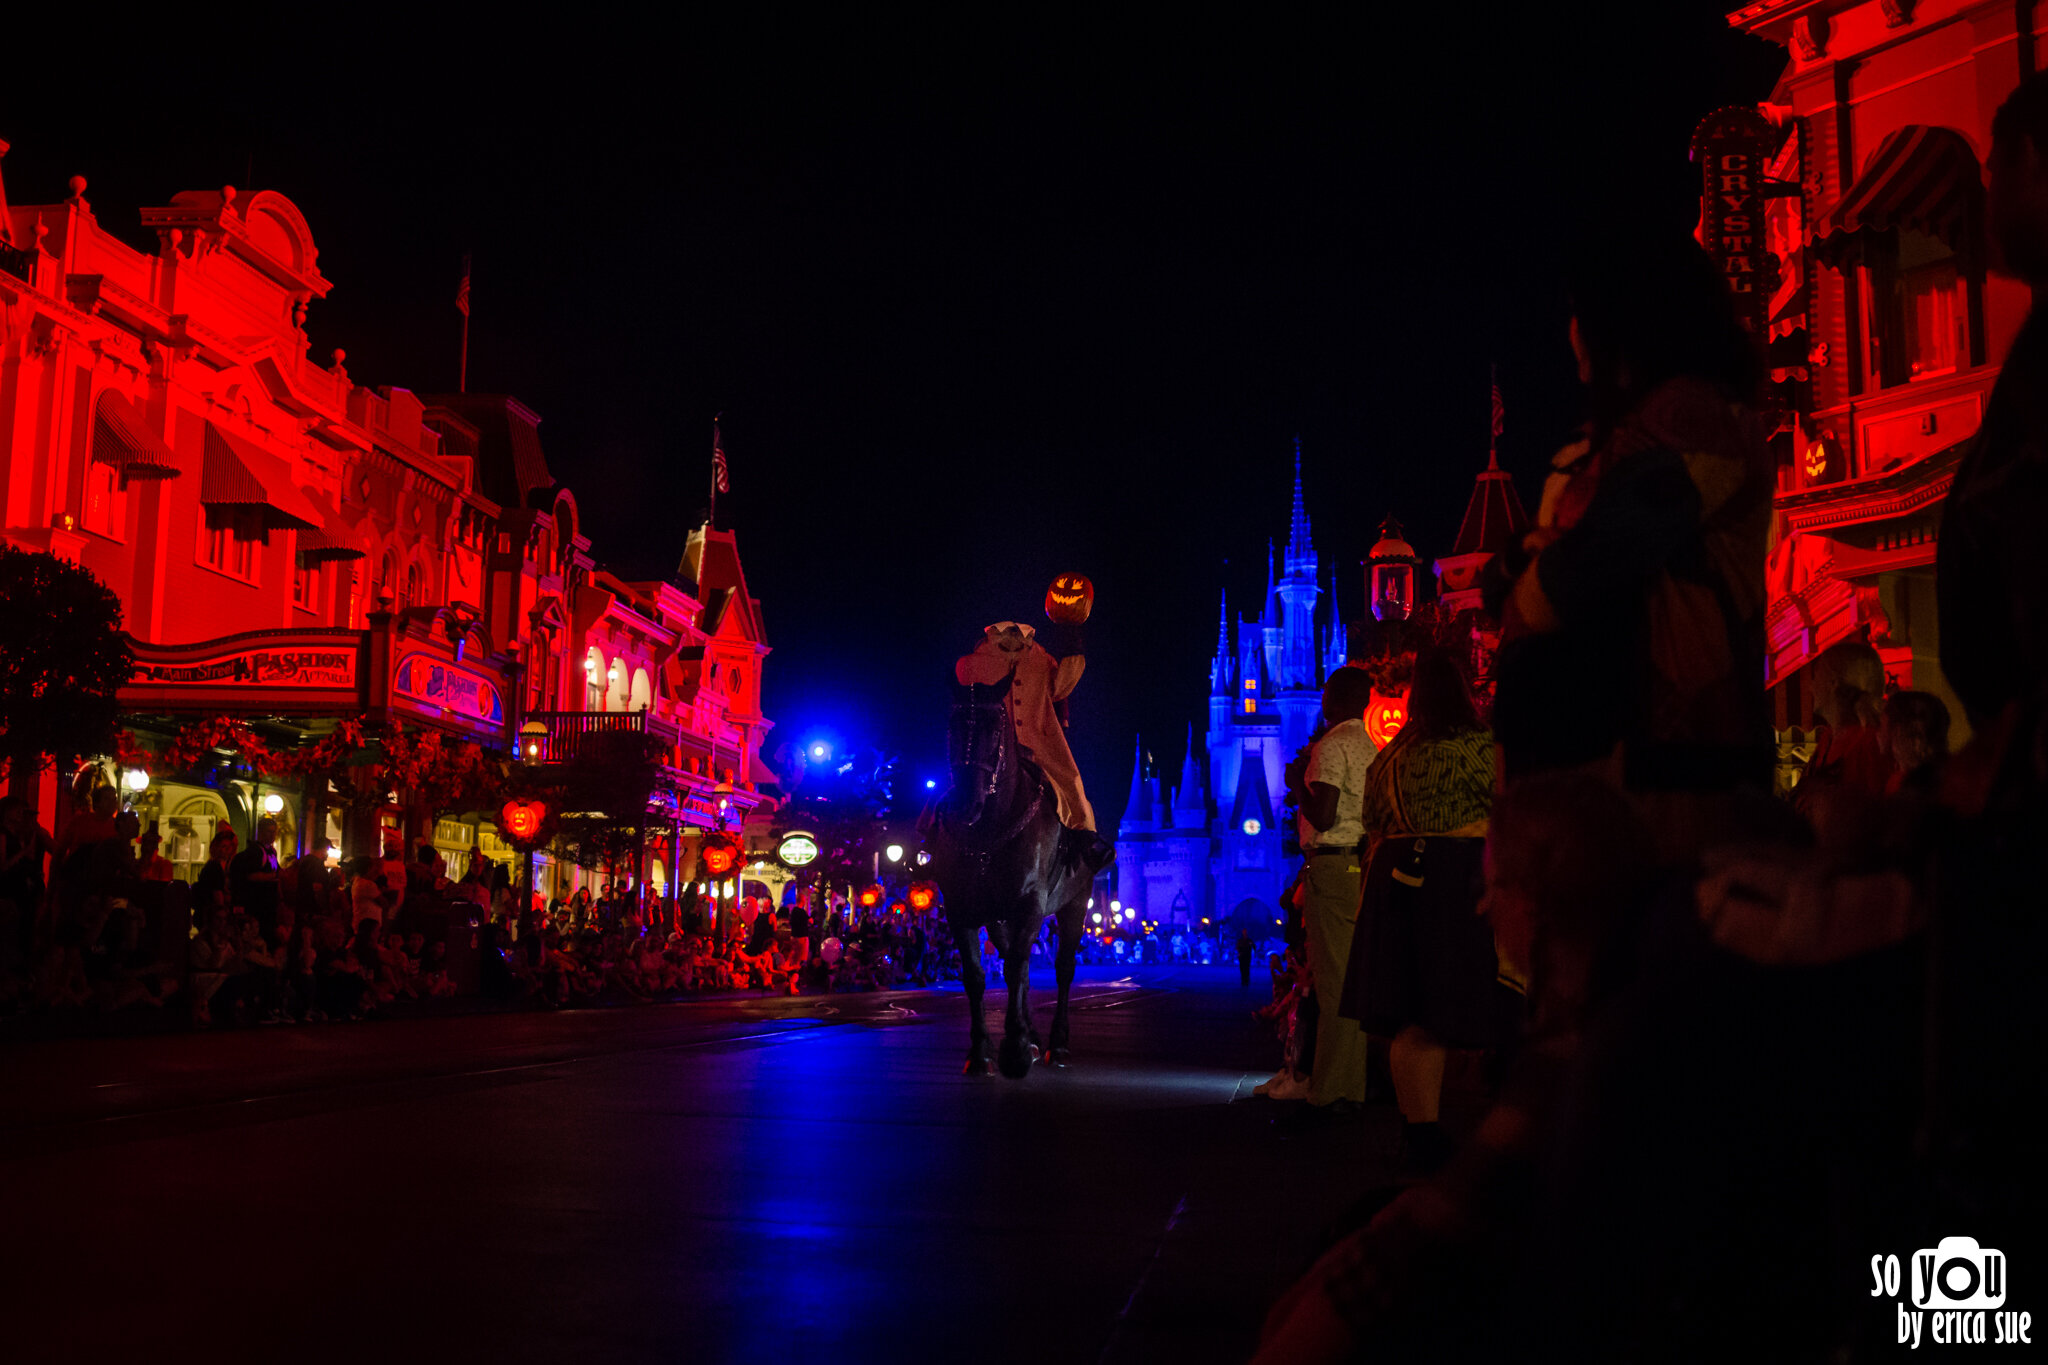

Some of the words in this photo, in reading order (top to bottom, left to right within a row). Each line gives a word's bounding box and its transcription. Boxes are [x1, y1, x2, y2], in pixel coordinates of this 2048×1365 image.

[1720, 154, 1754, 293] CRYSTAL
[161, 666, 192, 681] Main
[197, 659, 235, 680] Street
[248, 652, 351, 683] FASHION
